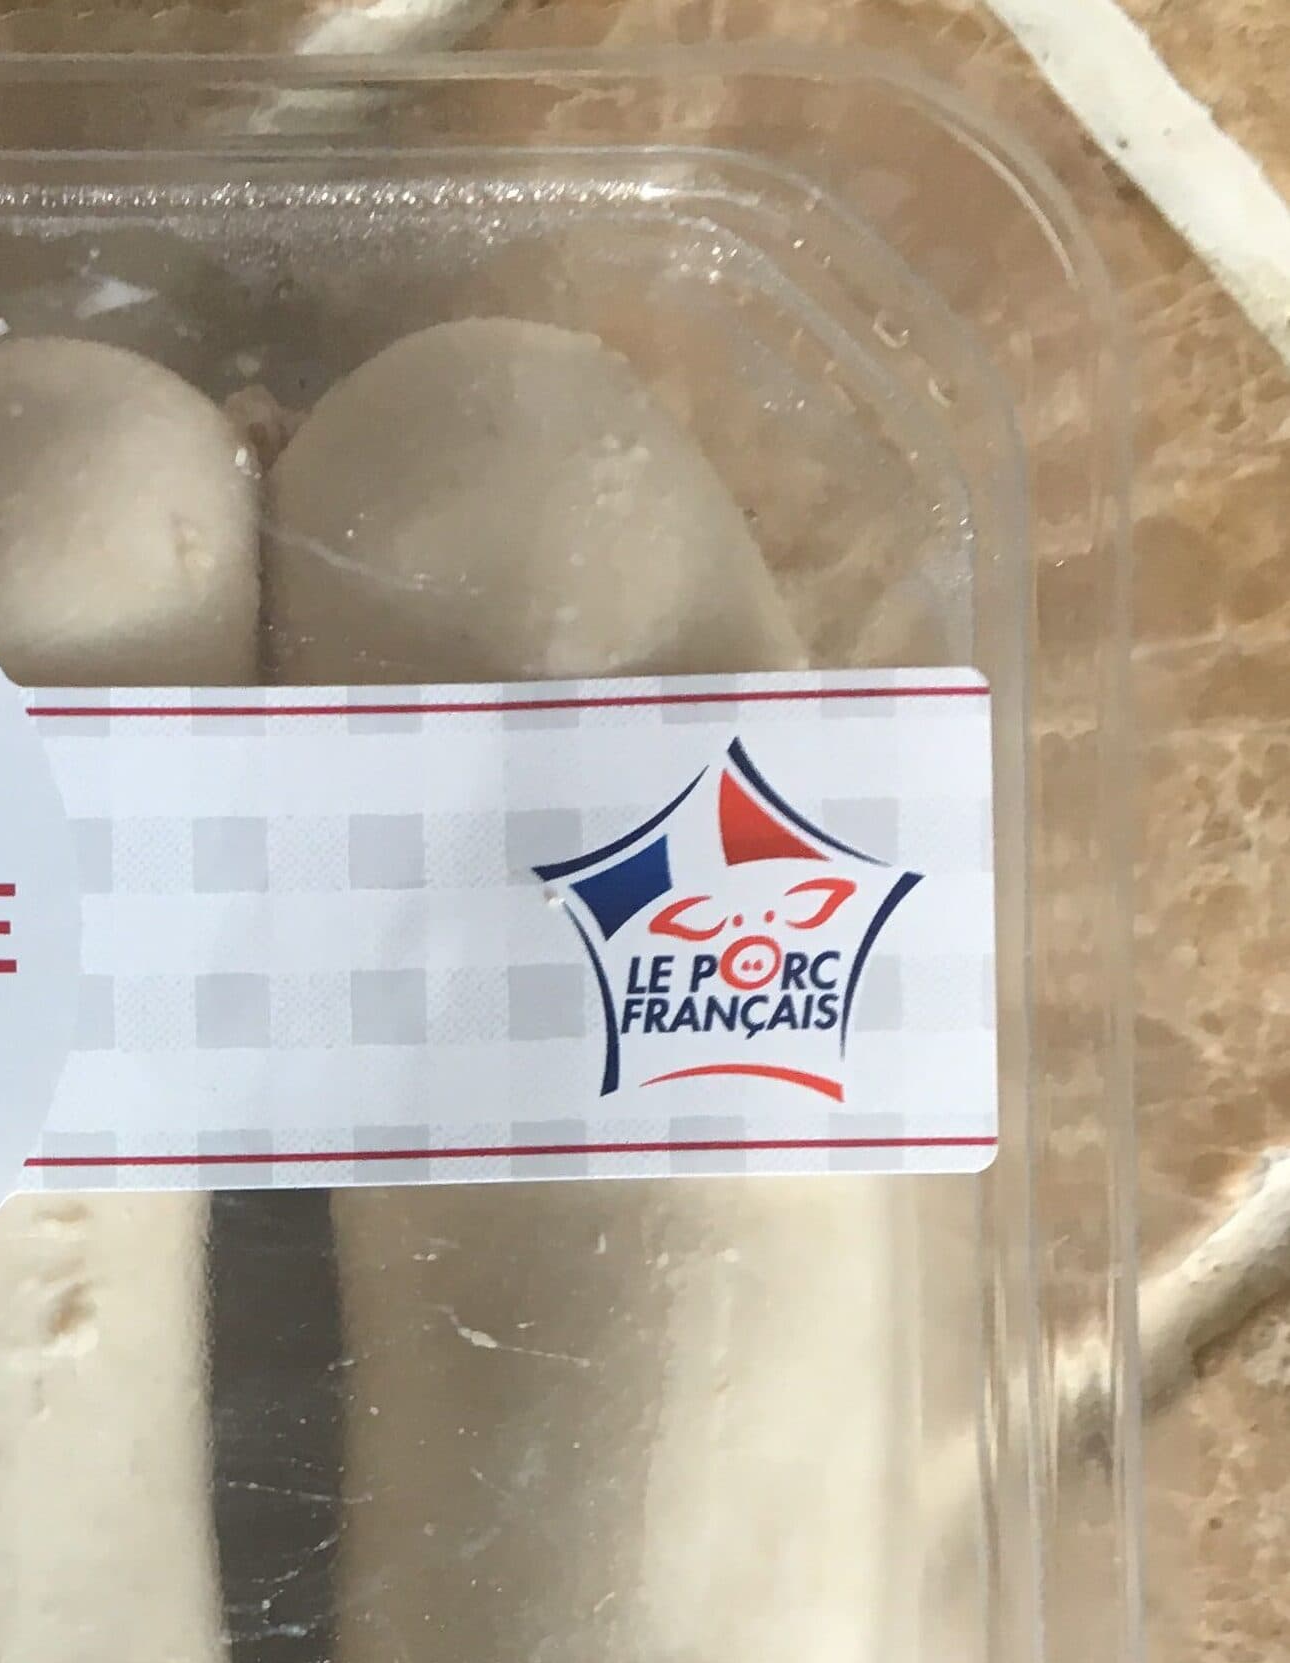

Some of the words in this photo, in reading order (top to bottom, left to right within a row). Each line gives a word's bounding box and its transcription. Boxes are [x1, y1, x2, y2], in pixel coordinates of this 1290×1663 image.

[626, 955, 675, 995] LE
[690, 935, 842, 991] PORC
[620, 994, 840, 1039] FRANÇAIS
